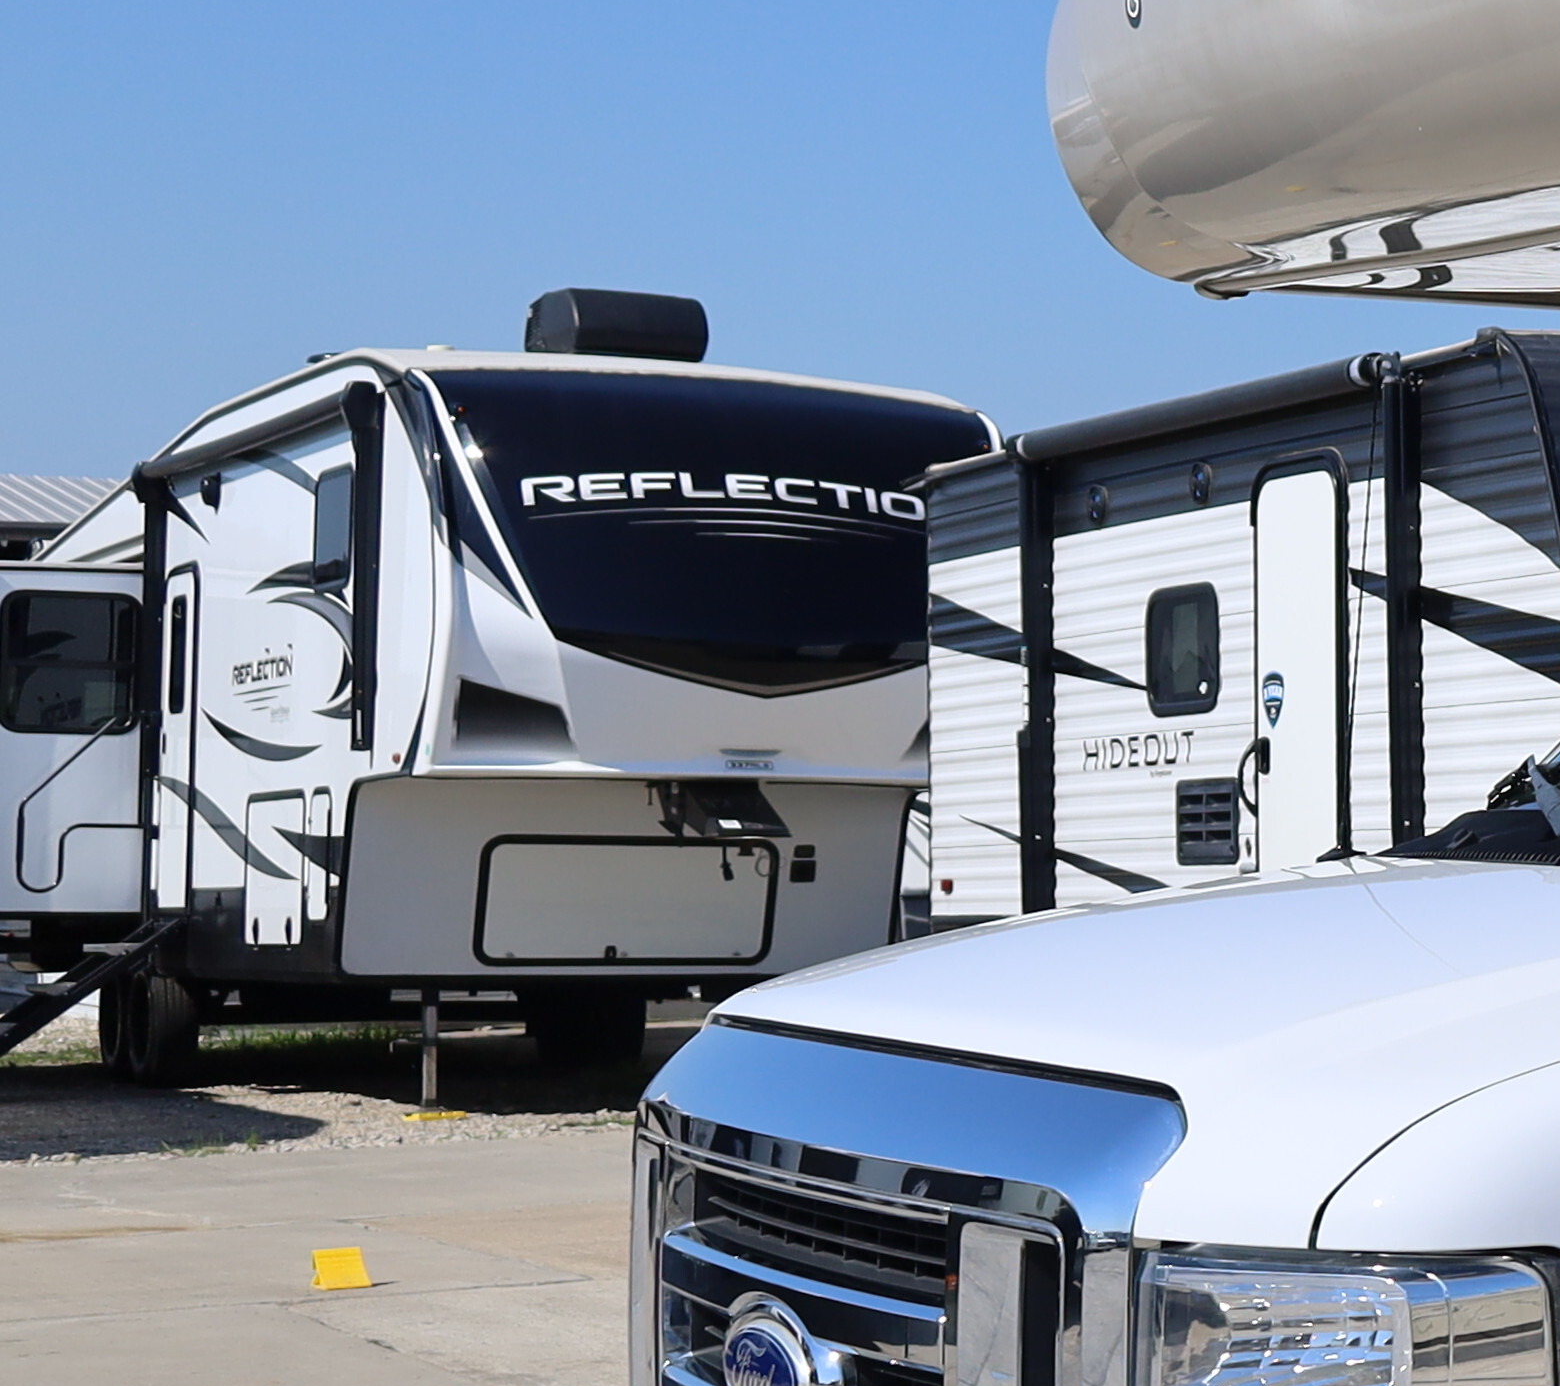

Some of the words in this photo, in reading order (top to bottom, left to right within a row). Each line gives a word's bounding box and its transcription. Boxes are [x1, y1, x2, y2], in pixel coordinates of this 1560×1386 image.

[521, 472, 926, 521] REFLECTIO
[232, 654, 293, 686] REFLECTION
[1083, 731, 1194, 771] HIDEOUT
